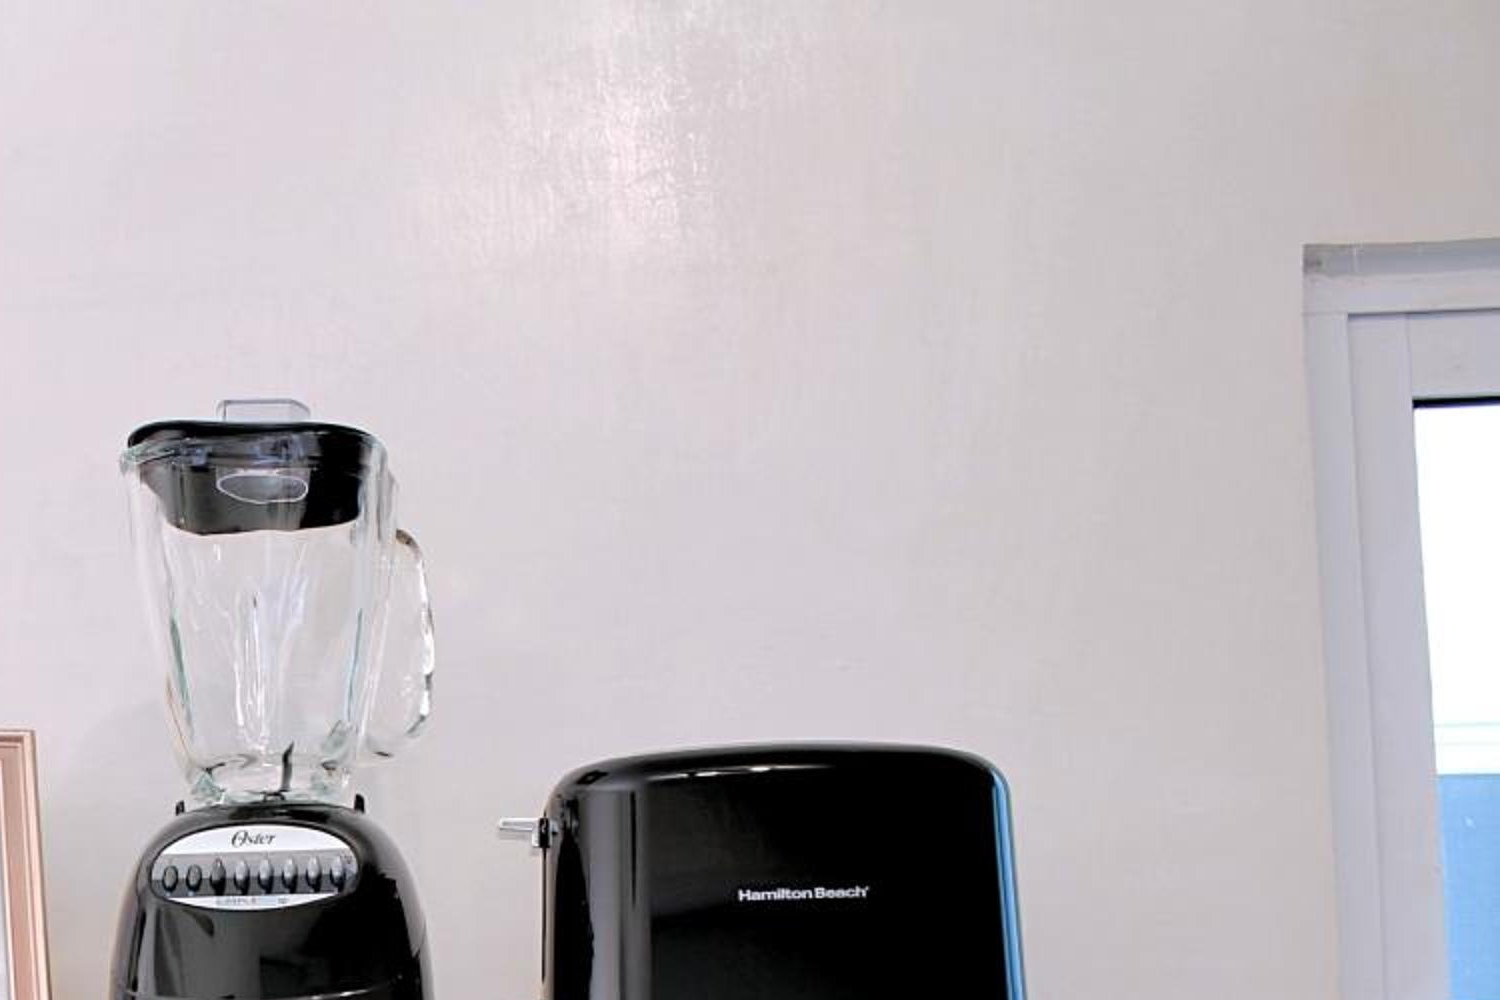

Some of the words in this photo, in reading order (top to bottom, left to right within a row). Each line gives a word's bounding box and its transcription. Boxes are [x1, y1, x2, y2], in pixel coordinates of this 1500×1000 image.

[231, 830, 276, 848] Oster
[738, 887, 813, 901] Hamilton
[814, 885, 868, 899] Beach
